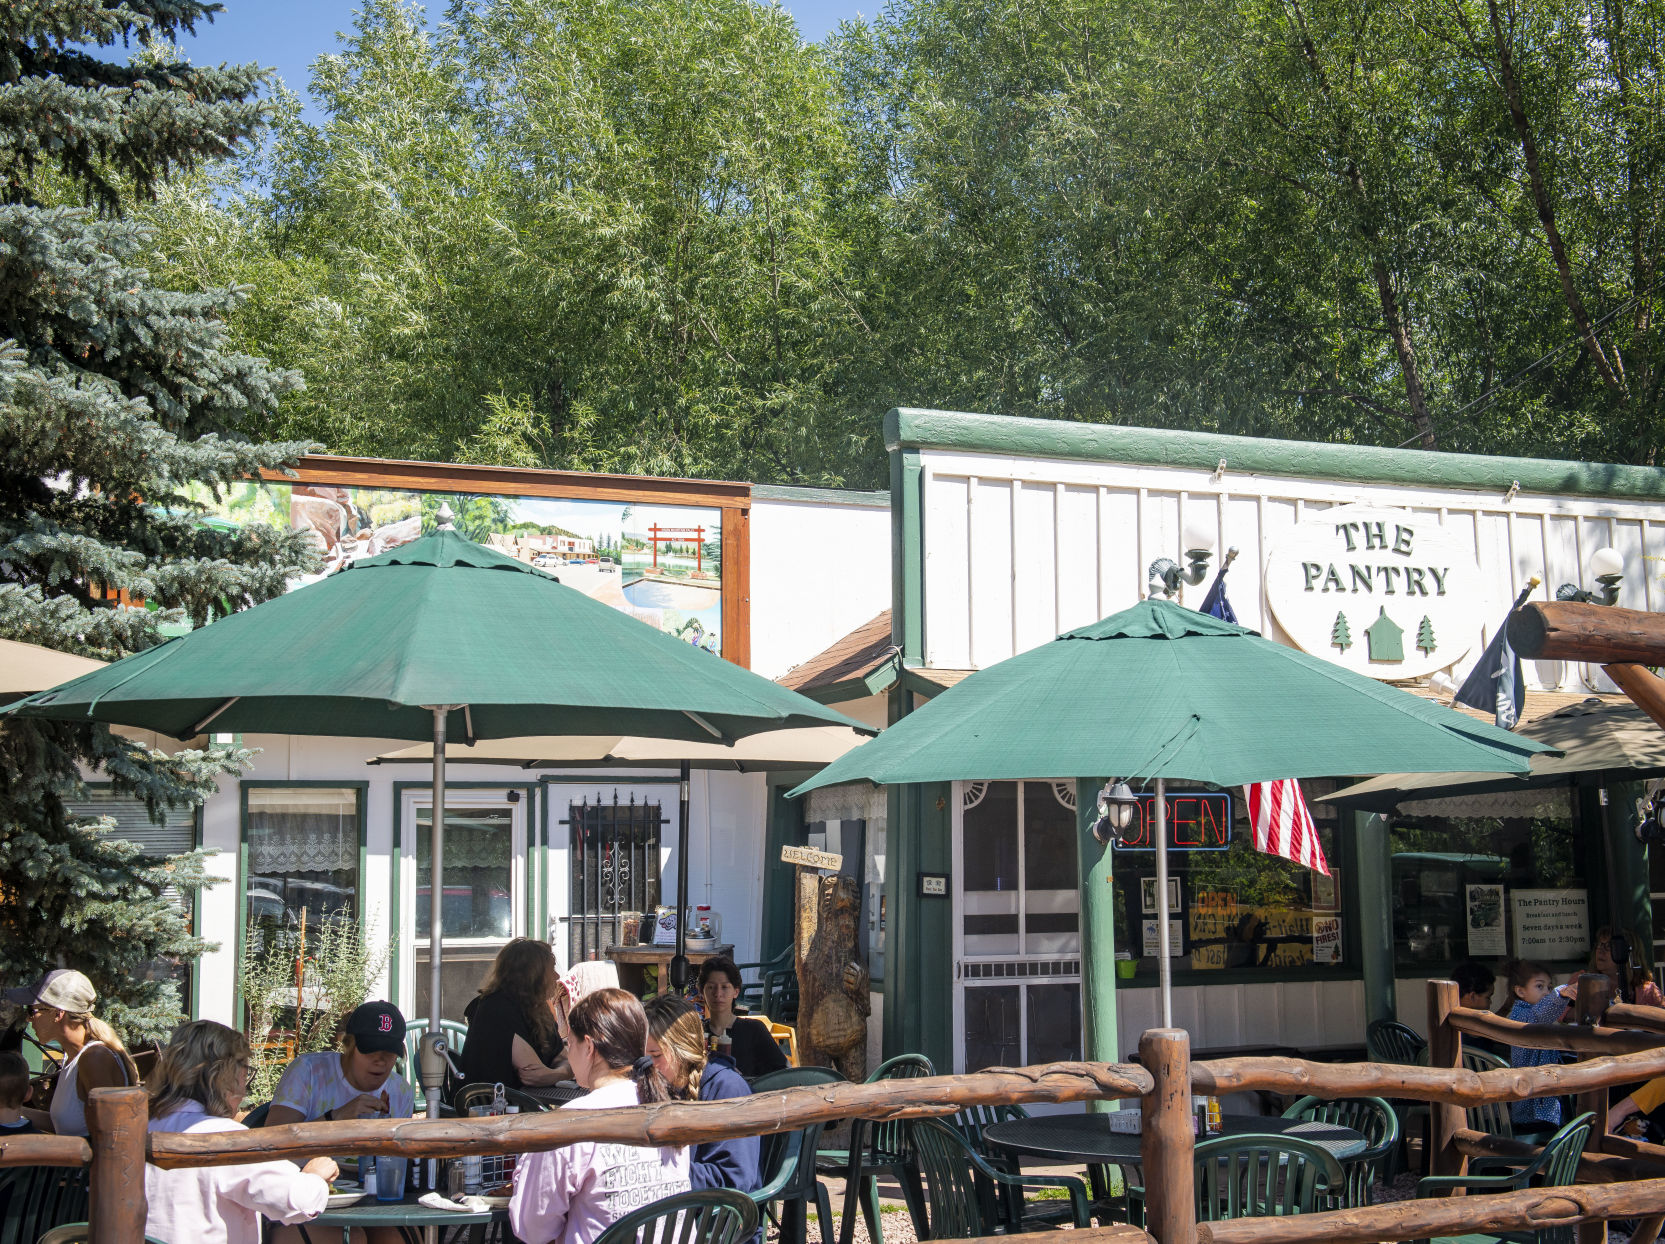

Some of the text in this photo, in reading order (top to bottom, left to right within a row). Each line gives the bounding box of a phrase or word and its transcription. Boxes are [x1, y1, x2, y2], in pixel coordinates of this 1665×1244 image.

[1335, 521, 1415, 557] THE
[1301, 562, 1450, 597] PANTRY
[1120, 799, 1226, 845] OPEN
[783, 849, 838, 867] WELCOME
[1198, 890, 1237, 915] OPEN
[1517, 897, 1586, 907] The Pantry Hours
[1323, 919, 1339, 933] NO
[1522, 924, 1542, 932] Seven
[1543, 924, 1559, 932] days
[1315, 932, 1340, 945] FIRES!
[1558, 936, 1586, 944] 2:30pm
[378, 1013, 393, 1032] B
[600, 1143, 640, 1167] WE
[605, 1160, 664, 1190] FIGHT
[605, 1180, 693, 1210] TOGETHER
